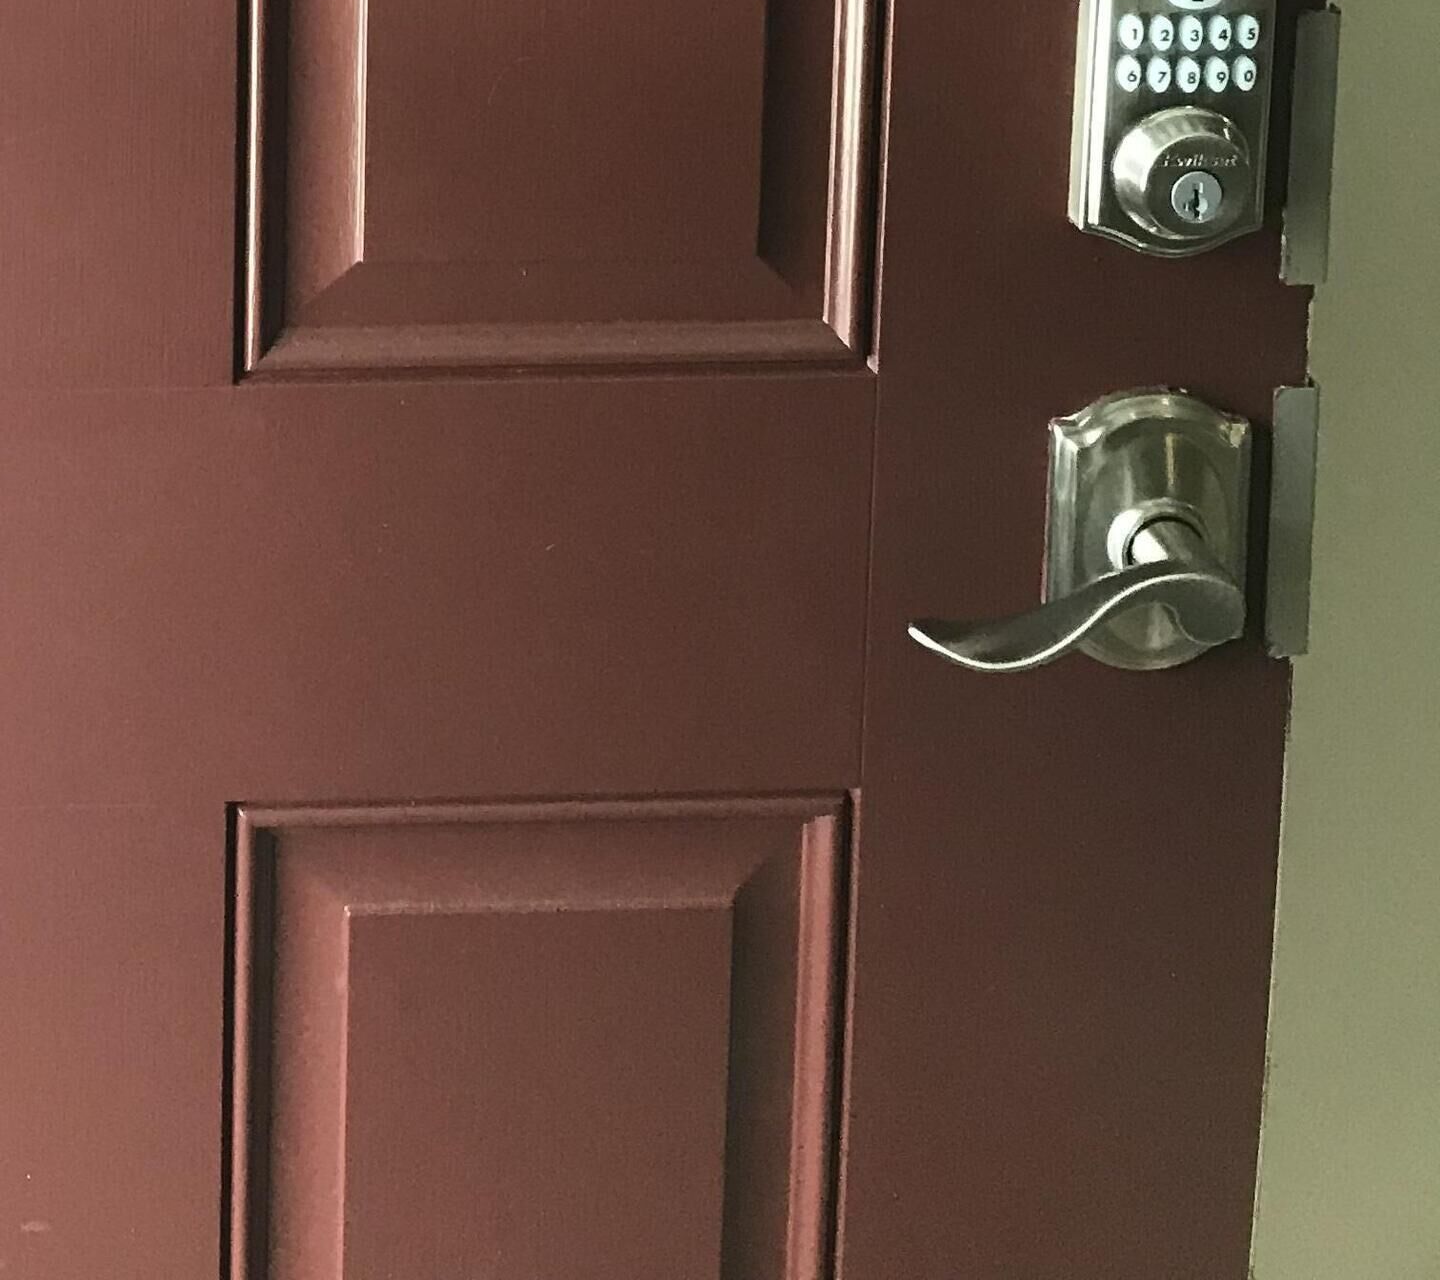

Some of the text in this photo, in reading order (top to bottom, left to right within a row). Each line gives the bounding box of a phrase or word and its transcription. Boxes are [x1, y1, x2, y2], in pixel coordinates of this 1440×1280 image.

[1132, 27, 1256, 42] 1 2 3 4 5
[1127, 69, 1253, 84] 6 7 8 9 0
